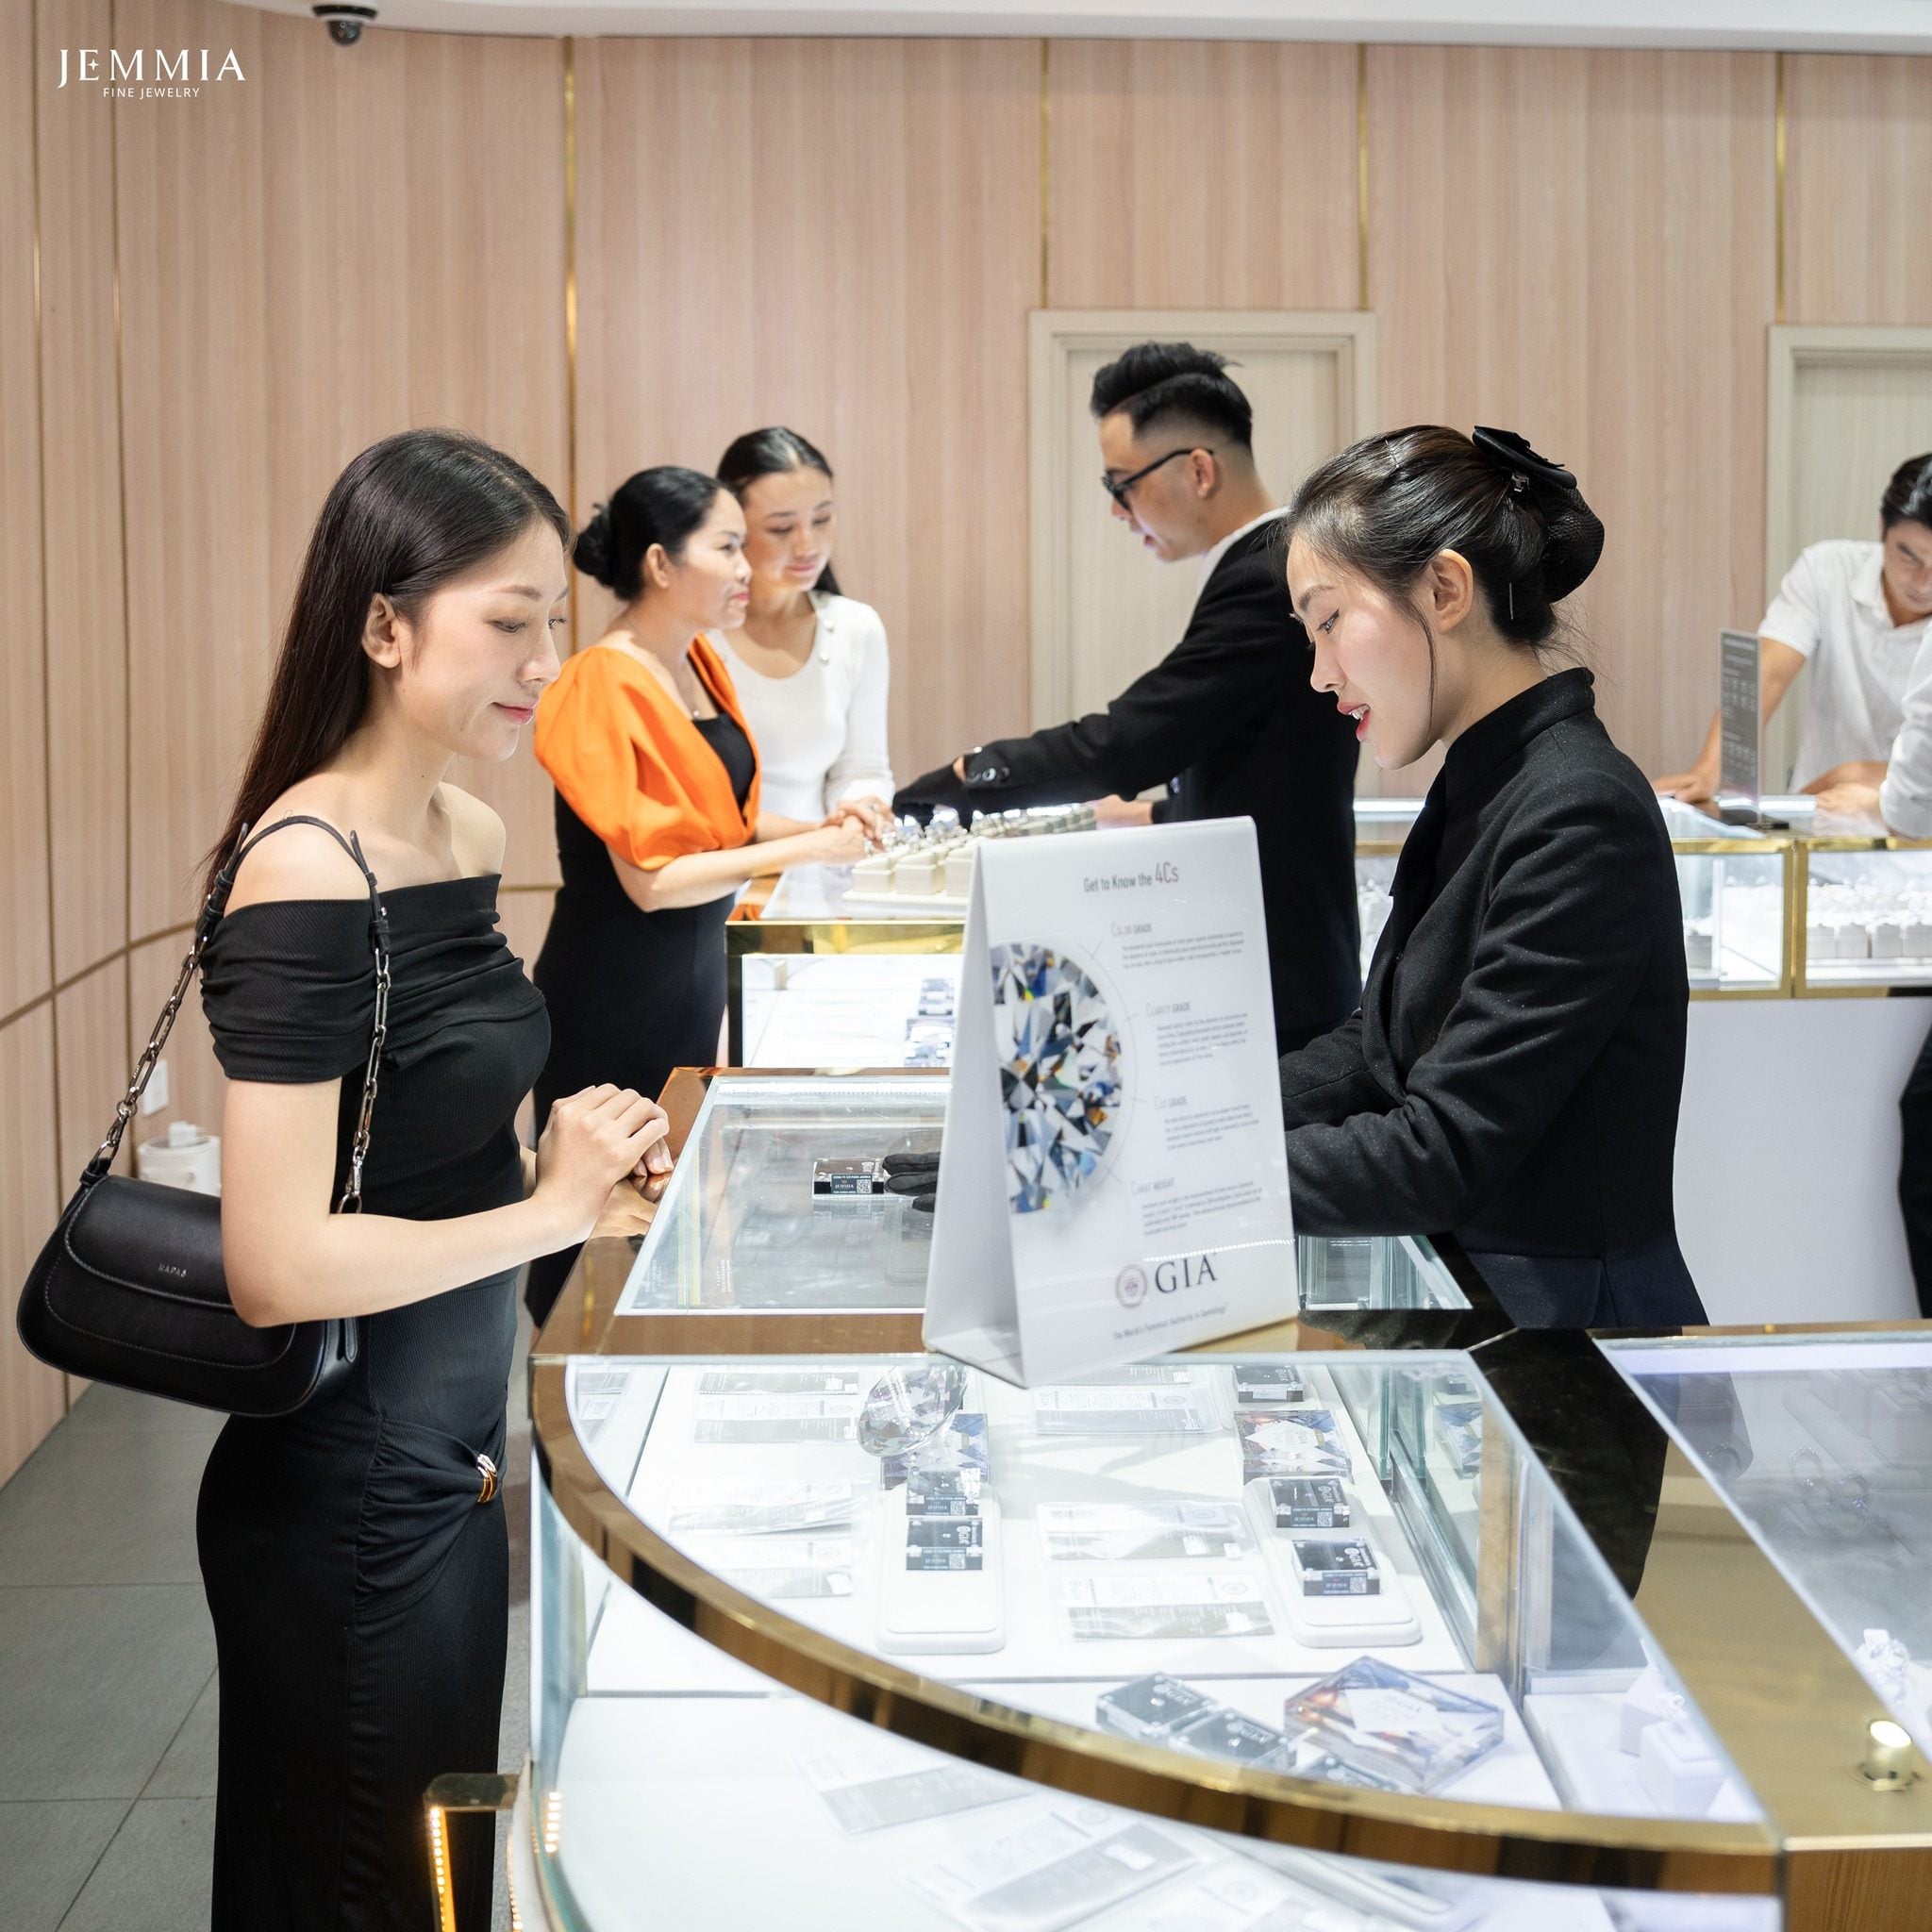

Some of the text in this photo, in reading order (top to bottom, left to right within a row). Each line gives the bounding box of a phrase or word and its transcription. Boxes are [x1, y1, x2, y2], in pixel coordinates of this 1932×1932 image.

[1083, 861, 1179, 892] Get to Know the 4Cs
[1154, 1254, 1218, 1294] GIA
